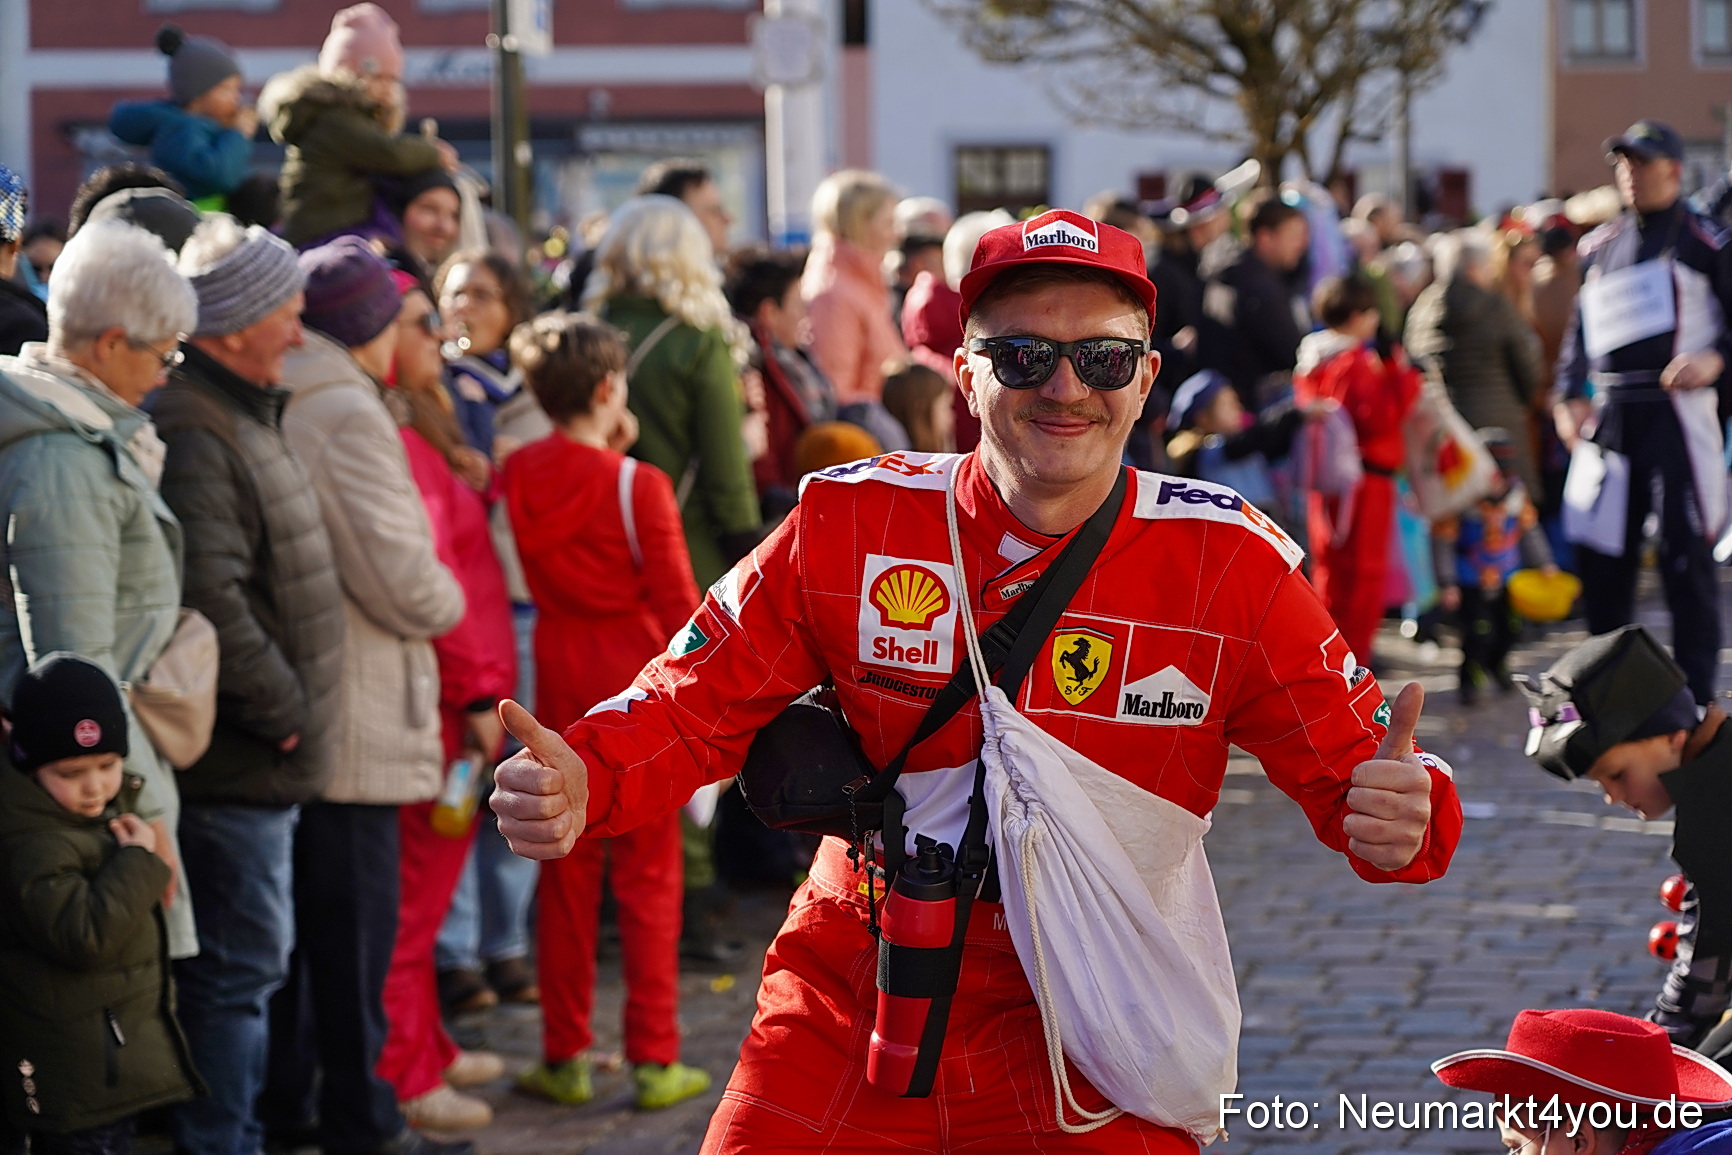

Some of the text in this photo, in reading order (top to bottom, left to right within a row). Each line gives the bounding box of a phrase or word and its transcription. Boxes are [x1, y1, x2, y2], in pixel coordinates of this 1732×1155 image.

[1025, 229, 1096, 250] Marlboro
[872, 636, 938, 665] Shell
[858, 671, 943, 699] BRIDGESTO
[1122, 691, 1204, 720] Marlboro
